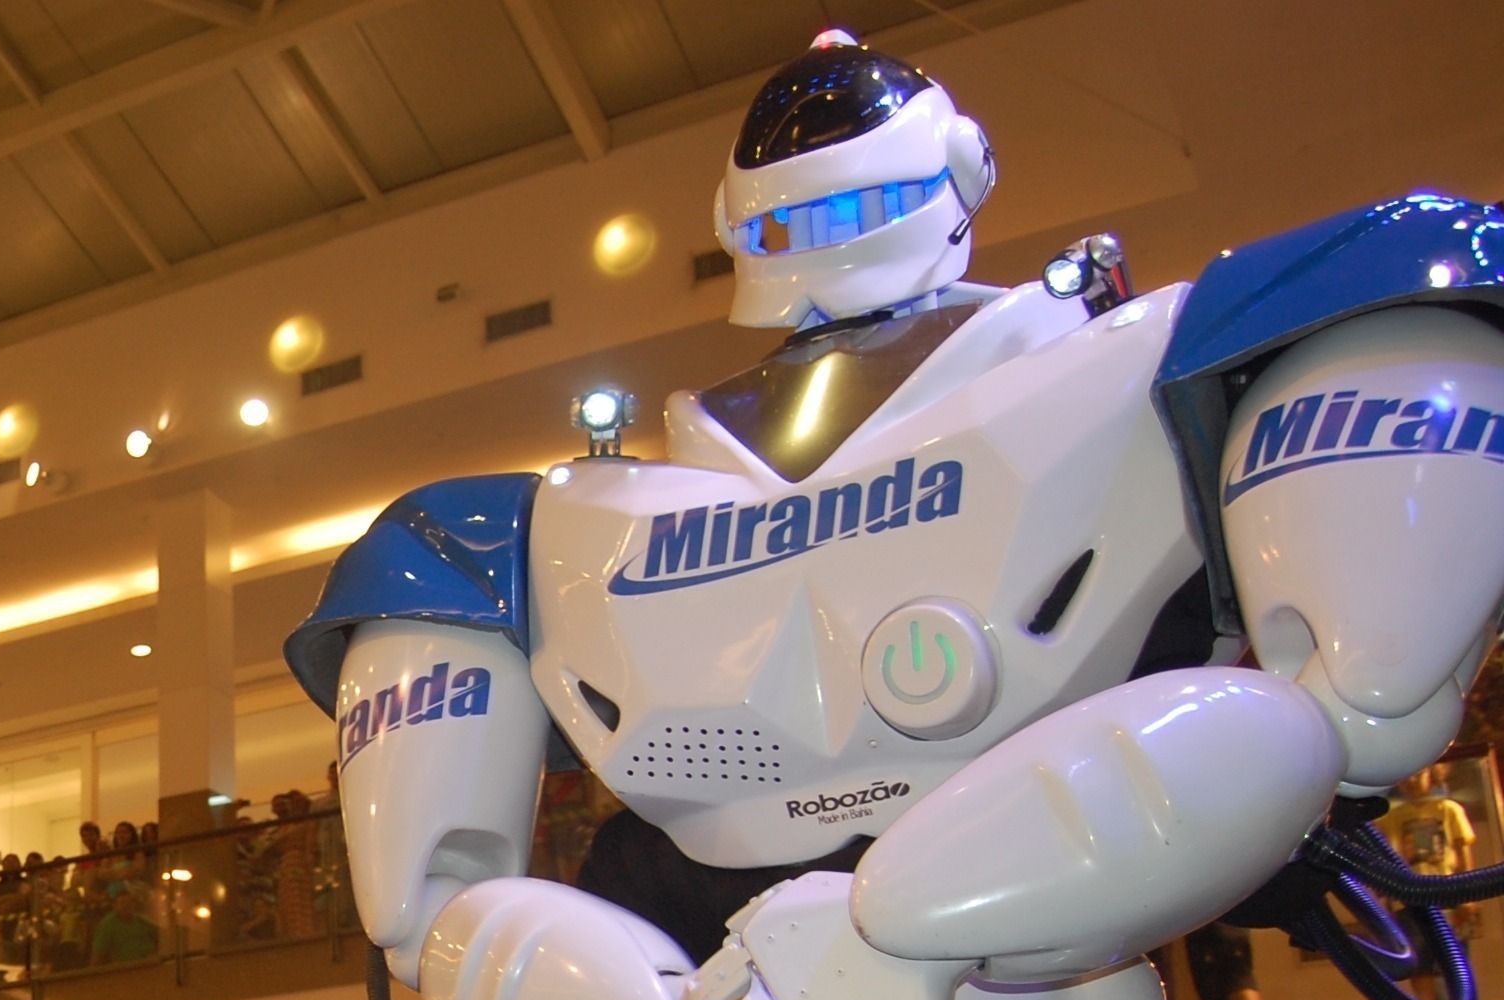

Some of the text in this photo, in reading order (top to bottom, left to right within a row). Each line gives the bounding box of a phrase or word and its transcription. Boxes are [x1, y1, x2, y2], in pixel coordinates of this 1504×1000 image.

[642, 457, 964, 580] Miranda
[817, 807, 874, 825] Made in Bahia
